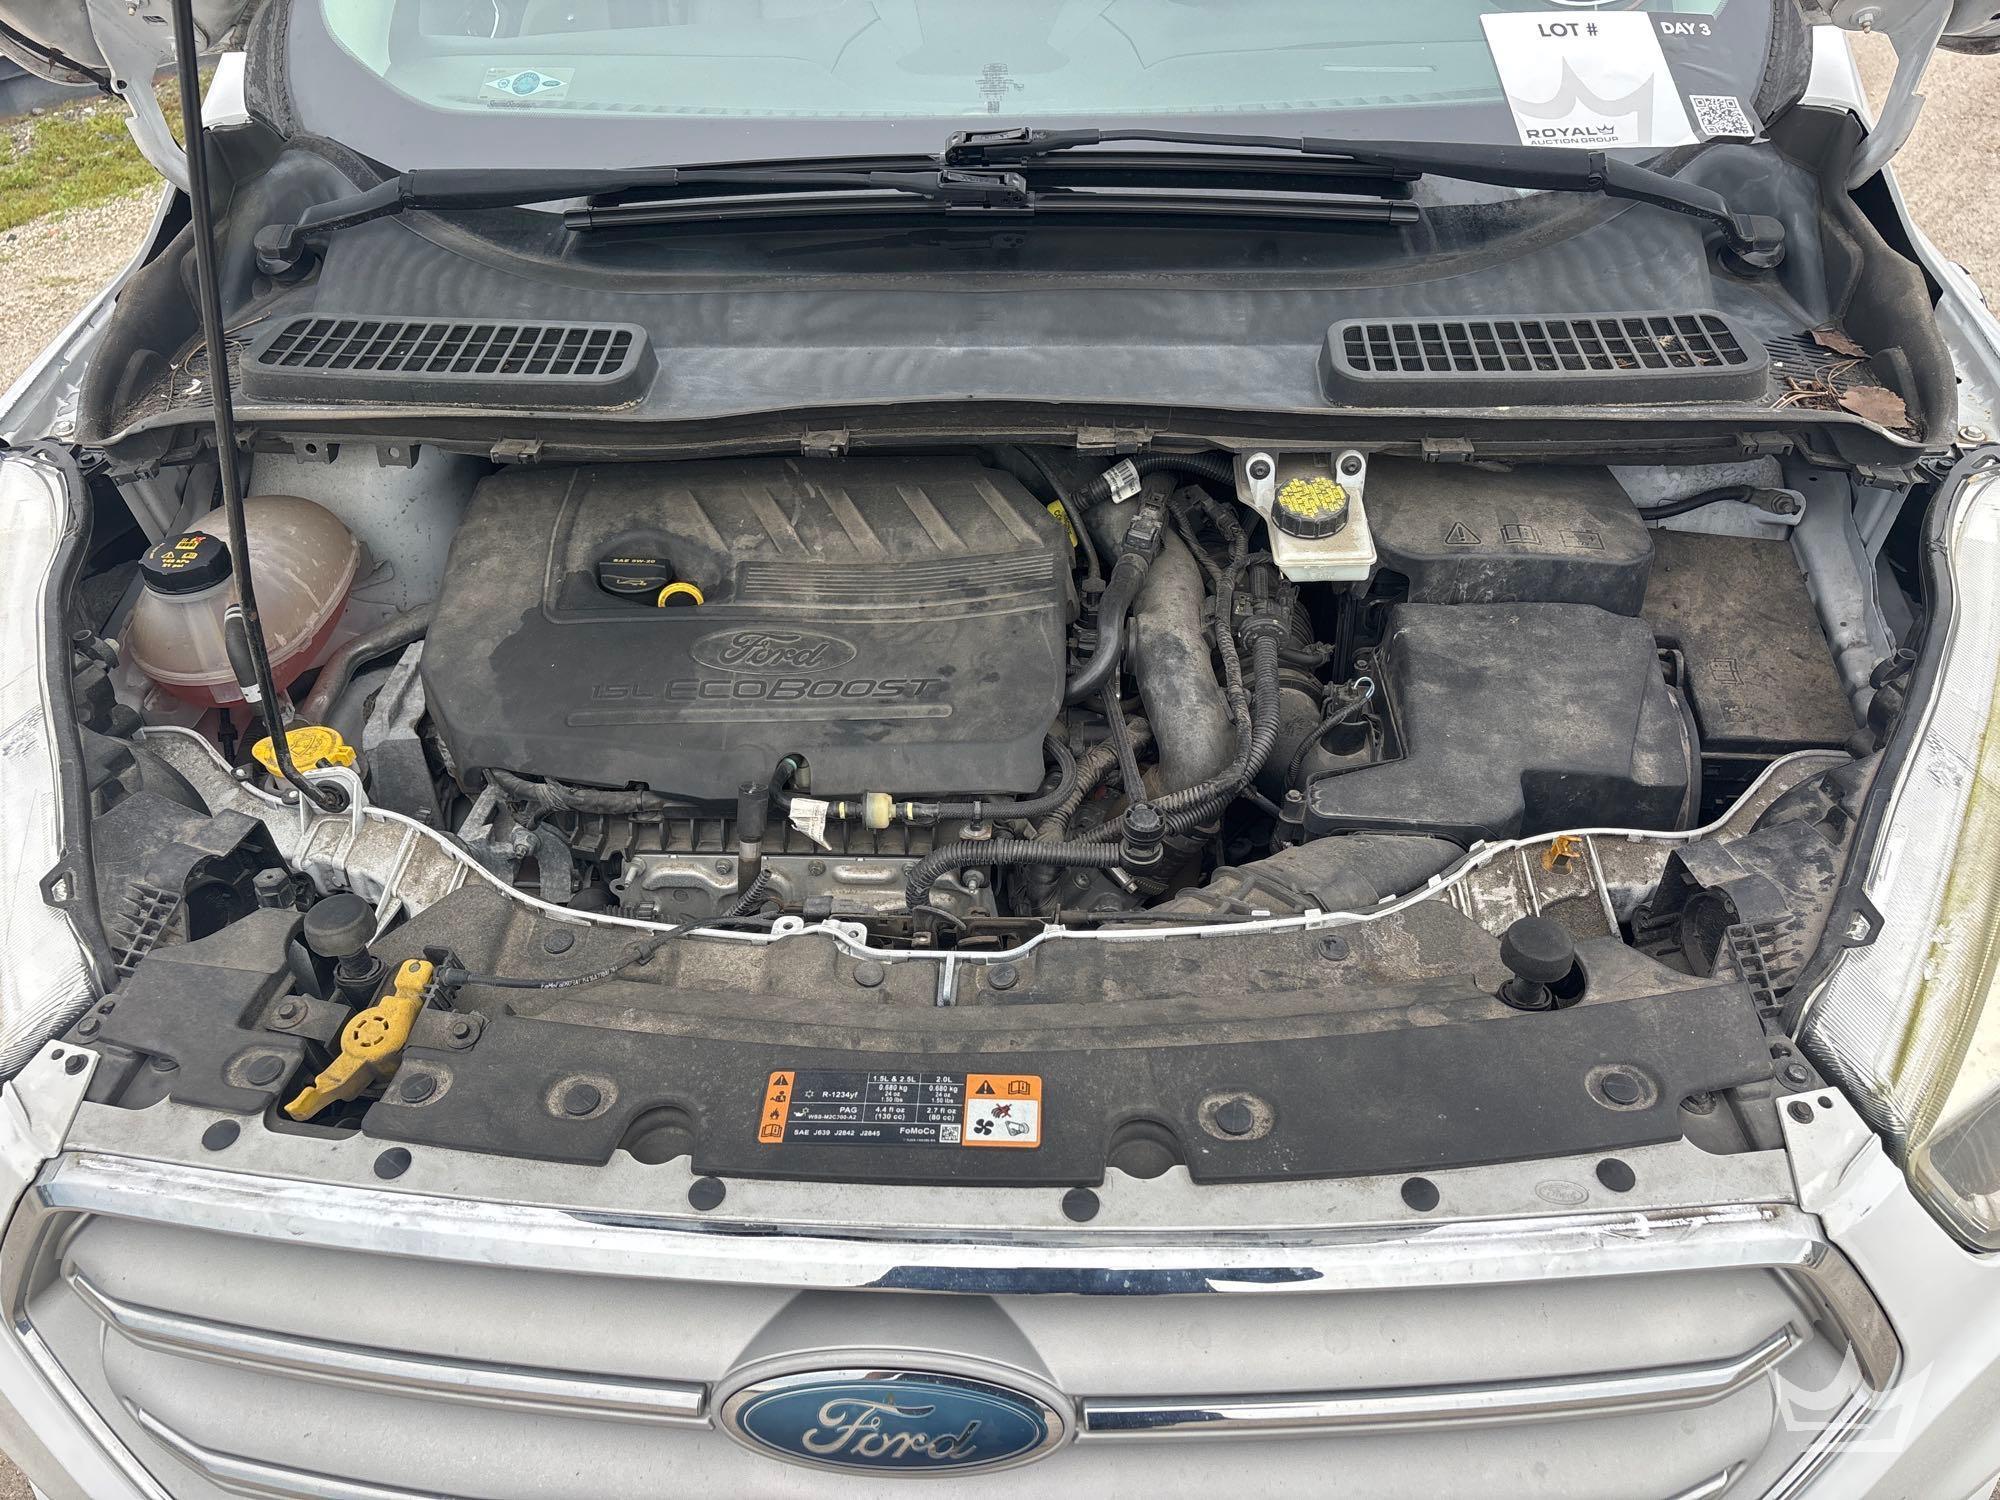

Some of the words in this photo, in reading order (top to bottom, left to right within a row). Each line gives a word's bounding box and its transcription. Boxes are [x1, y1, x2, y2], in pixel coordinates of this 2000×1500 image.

[1537, 23, 1579, 37] LOT
[1586, 22, 1599, 37] #
[1660, 21, 1695, 35] DAY
[1699, 23, 1712, 36] 3
[1526, 127, 1598, 138] ROYAL
[1531, 137, 1579, 145] AUCTION
[1581, 136, 1619, 144] GROUP
[717, 631, 830, 667] Ford
[899, 1084, 908, 1092] kg
[949, 1085, 958, 1093] kg
[822, 1090, 858, 1099] R-1234yf
[874, 1113, 892, 1121] (130
[893, 1113, 906, 1121] cc)
[942, 1114, 955, 1122] cc)
[899, 1127, 936, 1135] FoMoCo
[802, 1397, 982, 1460] Ford
